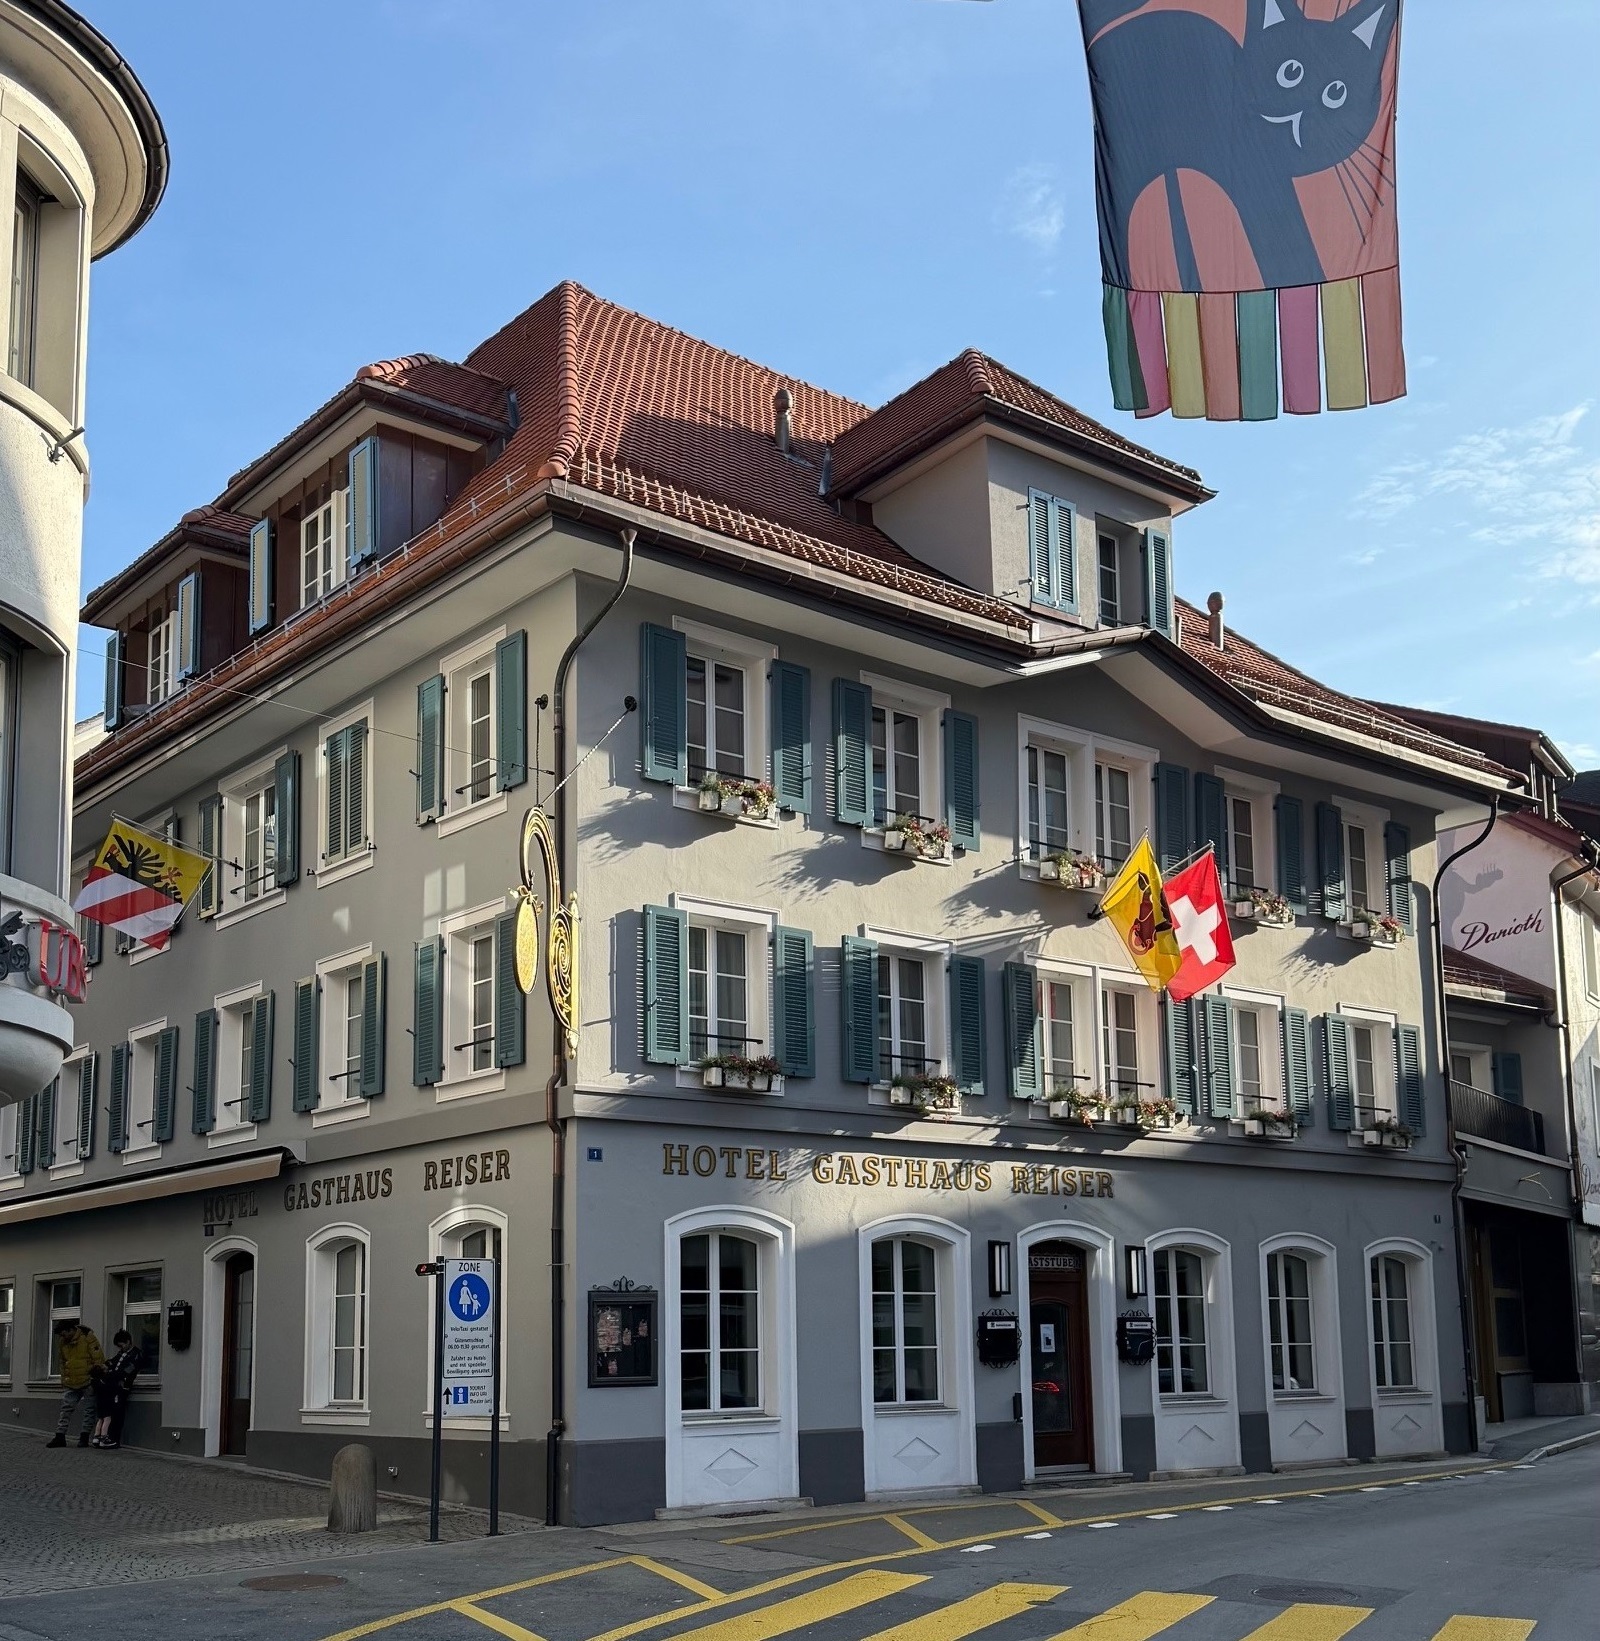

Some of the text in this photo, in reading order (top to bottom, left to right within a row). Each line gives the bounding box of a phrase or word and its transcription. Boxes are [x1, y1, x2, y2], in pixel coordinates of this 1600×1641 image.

[1460, 908, 1544, 952] Danioth
[203, 1149, 511, 1223] HOTEL GASTHAUS REISER
[662, 1143, 1114, 1198] HOTEL GASTHAUS REISER
[458, 1262, 481, 1272] ZONE
